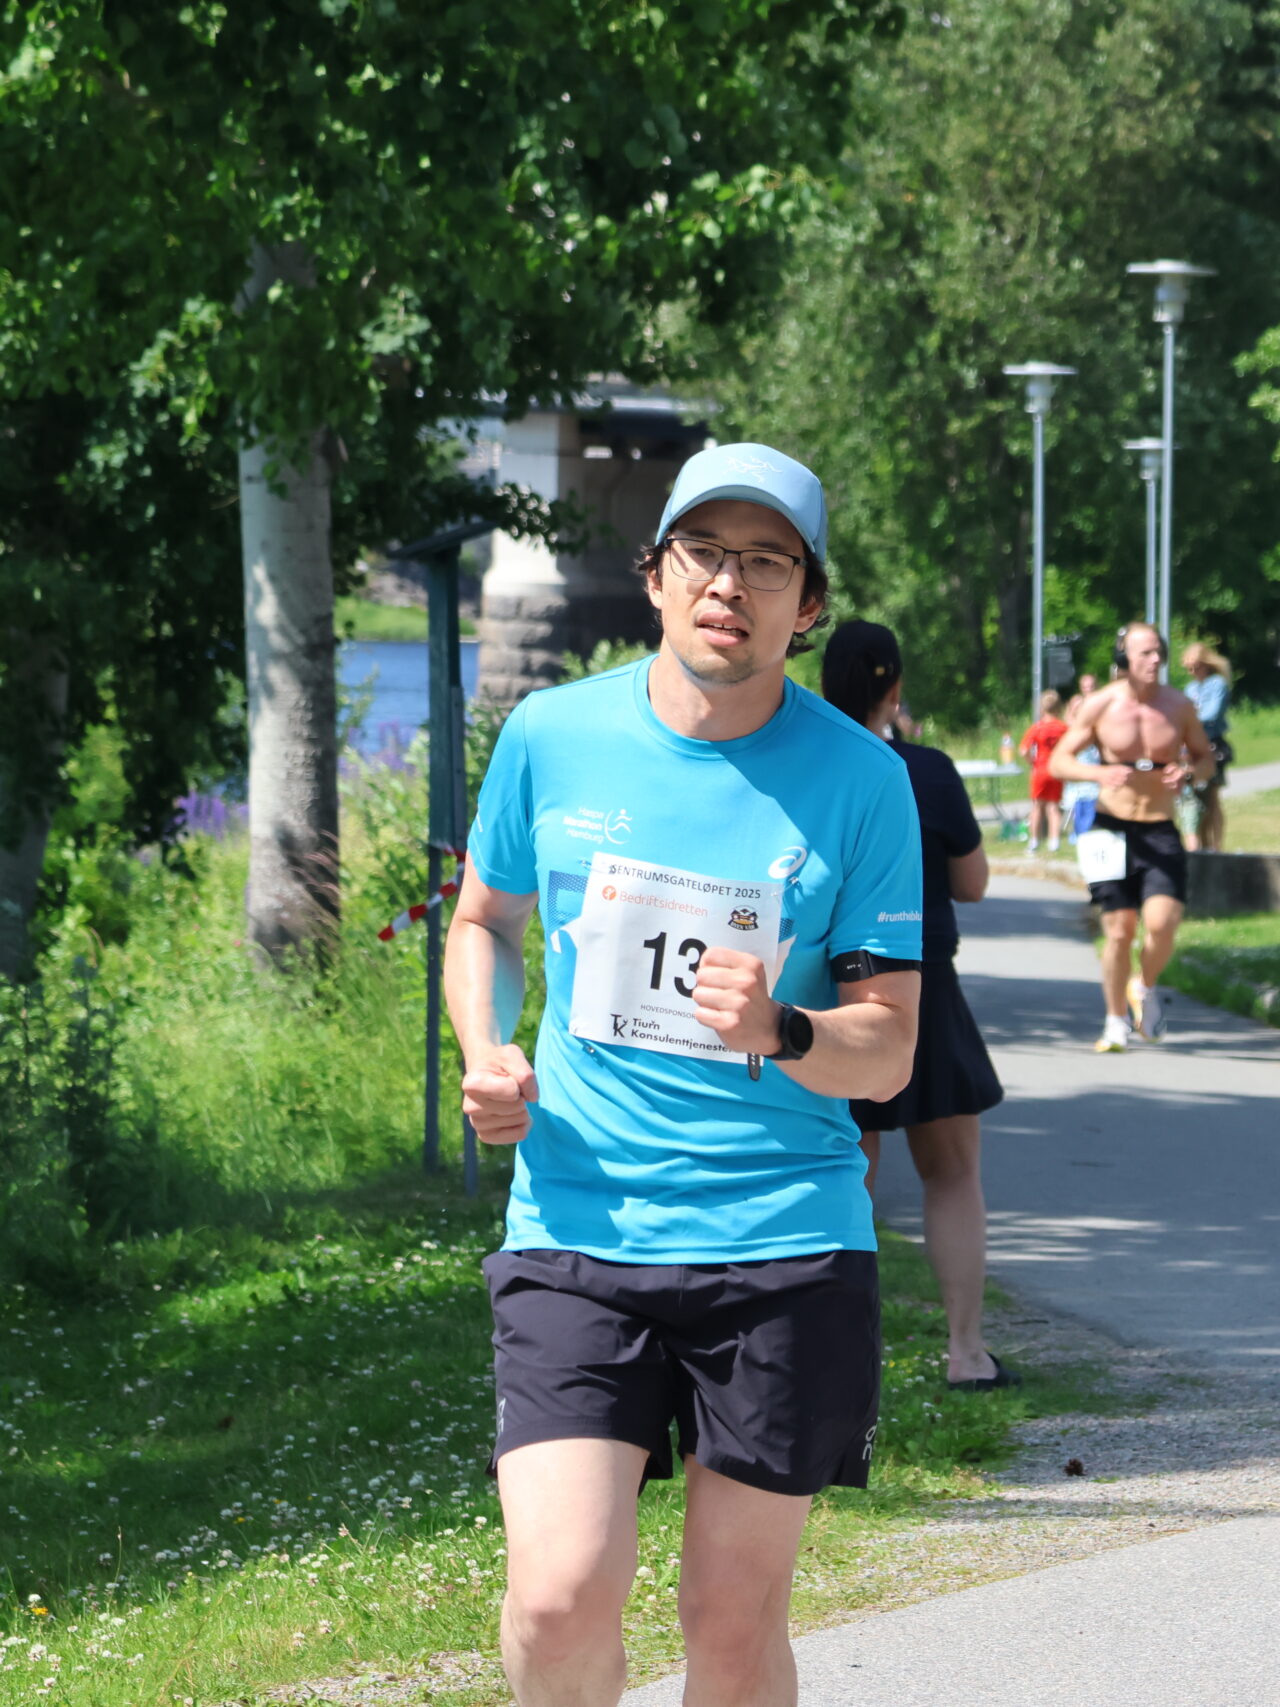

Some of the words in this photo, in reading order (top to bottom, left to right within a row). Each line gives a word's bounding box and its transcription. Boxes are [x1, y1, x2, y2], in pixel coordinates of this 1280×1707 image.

[562, 815, 603, 831] Marathon
[734, 887, 762, 900] 2025
[619, 891, 709, 918] Bedriftsidretten
[643, 930, 708, 999] 13
